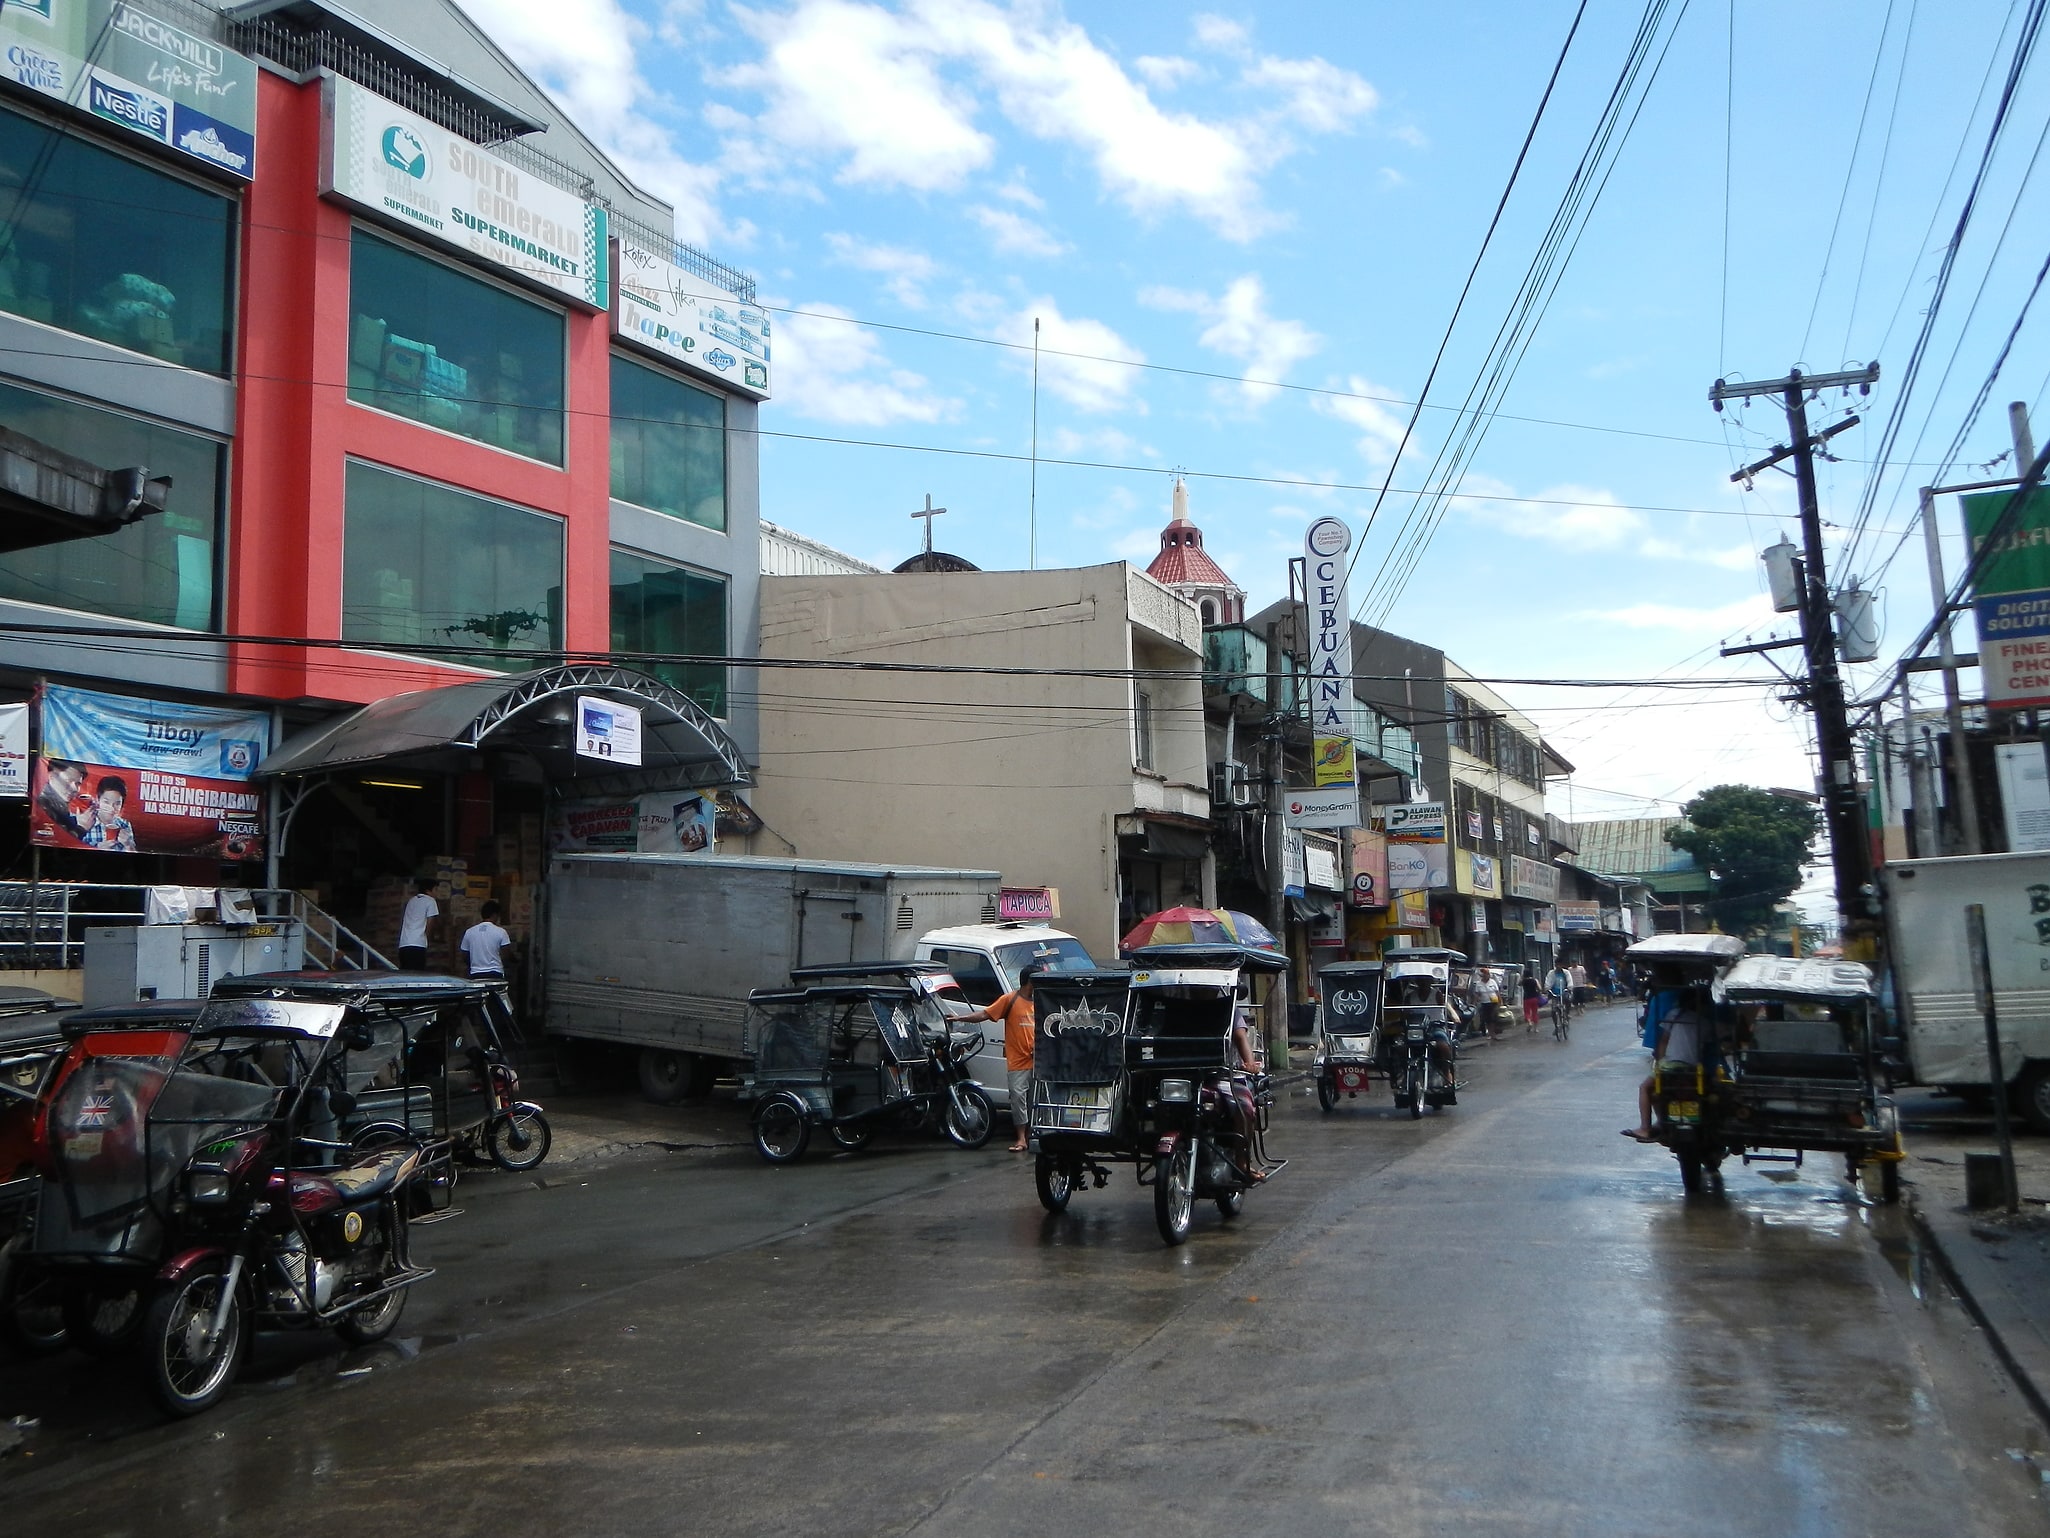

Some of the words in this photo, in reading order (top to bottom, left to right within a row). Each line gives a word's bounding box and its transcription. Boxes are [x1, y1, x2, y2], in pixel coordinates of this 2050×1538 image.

[8, 45, 61, 75] Cheez
[14, 66, 63, 90] Whiz
[449, 141, 519, 201] SOUTH
[383, 196, 444, 231] SUPERMARKET
[451, 207, 579, 276] SUPERMARKET
[624, 302, 696, 353] hapee
[1998, 600, 2050, 617] DIGIT
[1316, 561, 1343, 726] CEBUANA
[2001, 642, 2050, 657] FINE
[2009, 676, 2050, 690] CEN
[145, 719, 205, 748] Tibay
[161, 775, 174, 785] na
[175, 777, 187, 786] sa
[139, 783, 260, 811] NANGINGIBABAW
[1304, 804, 1352, 813] MoneyGram
[144, 802, 158, 813] NA
[158, 803, 188, 816] SARAP
[189, 806, 202, 817] NG
[203, 808, 226, 820] KAPE
[1389, 860, 1426, 871] BanKO
[1003, 893, 1051, 912] TAPIOCA
